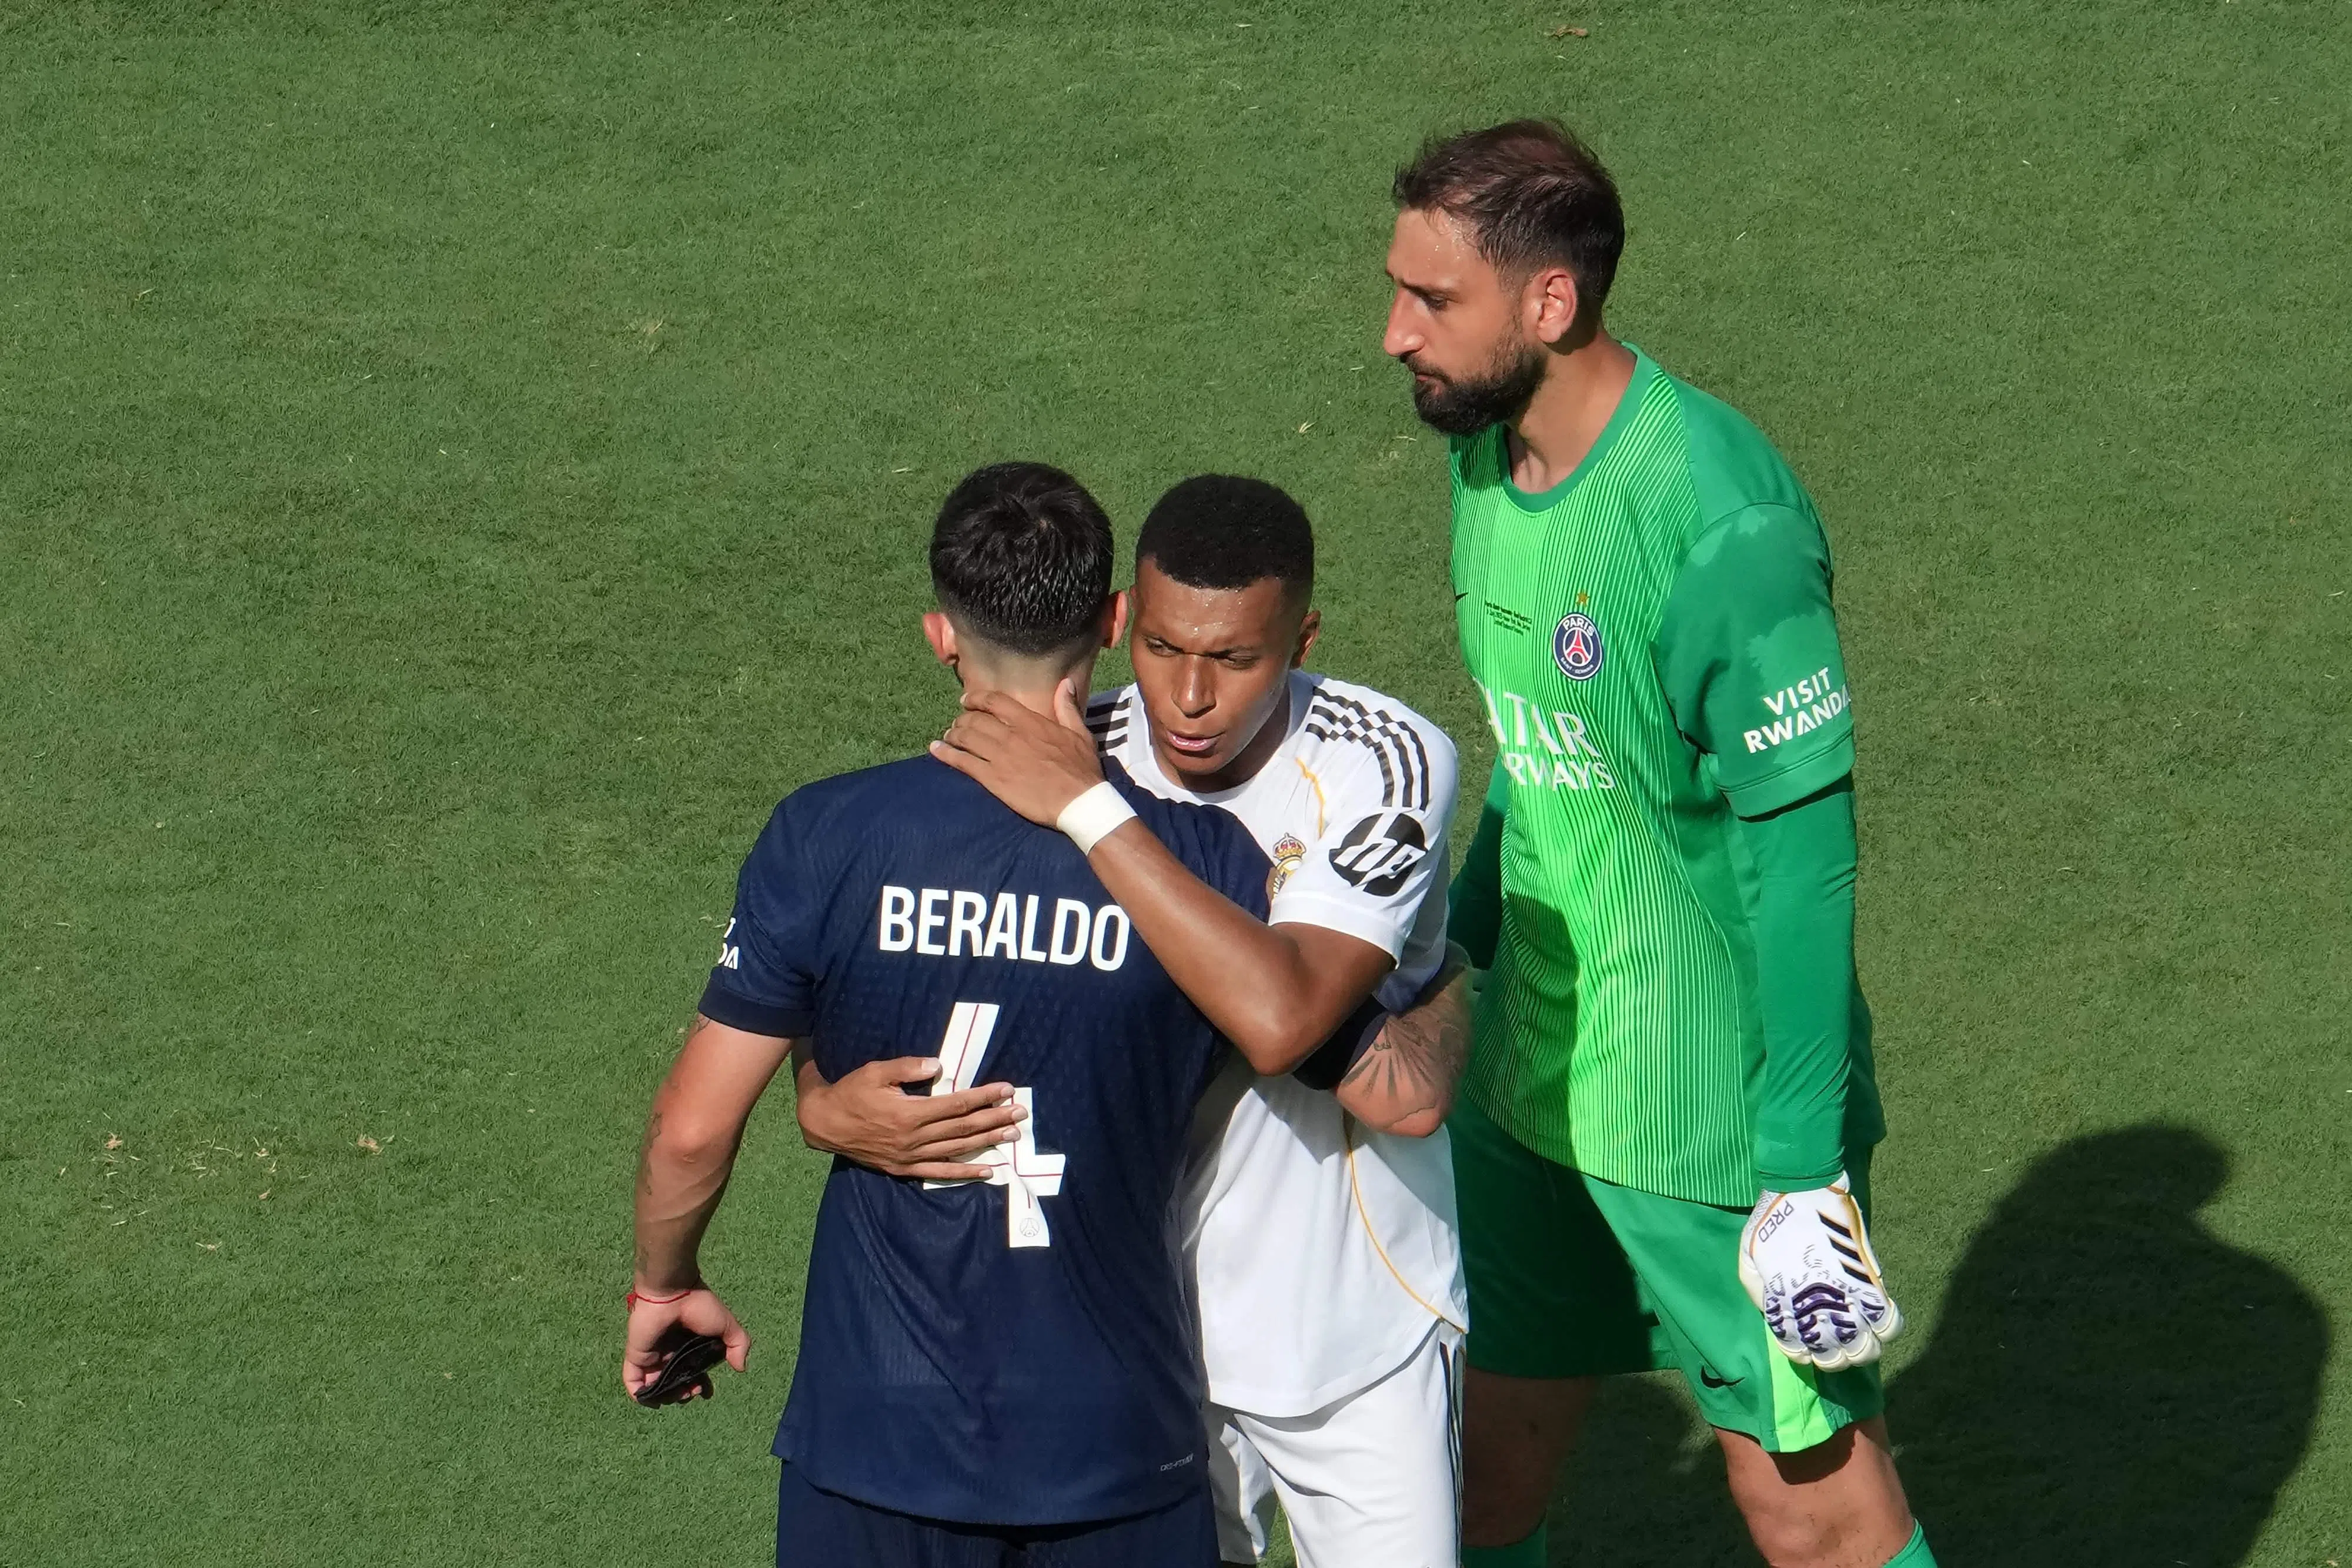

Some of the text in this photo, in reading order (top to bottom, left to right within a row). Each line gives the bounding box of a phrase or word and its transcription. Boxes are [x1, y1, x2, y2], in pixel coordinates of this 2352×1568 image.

[1562, 617, 1595, 636] PARIS
[1763, 667, 1830, 716] VISIT
[880, 885, 1130, 971] BERALDO
[923, 1001, 1066, 1248] 4
[1759, 1200, 1795, 1242] PRED
